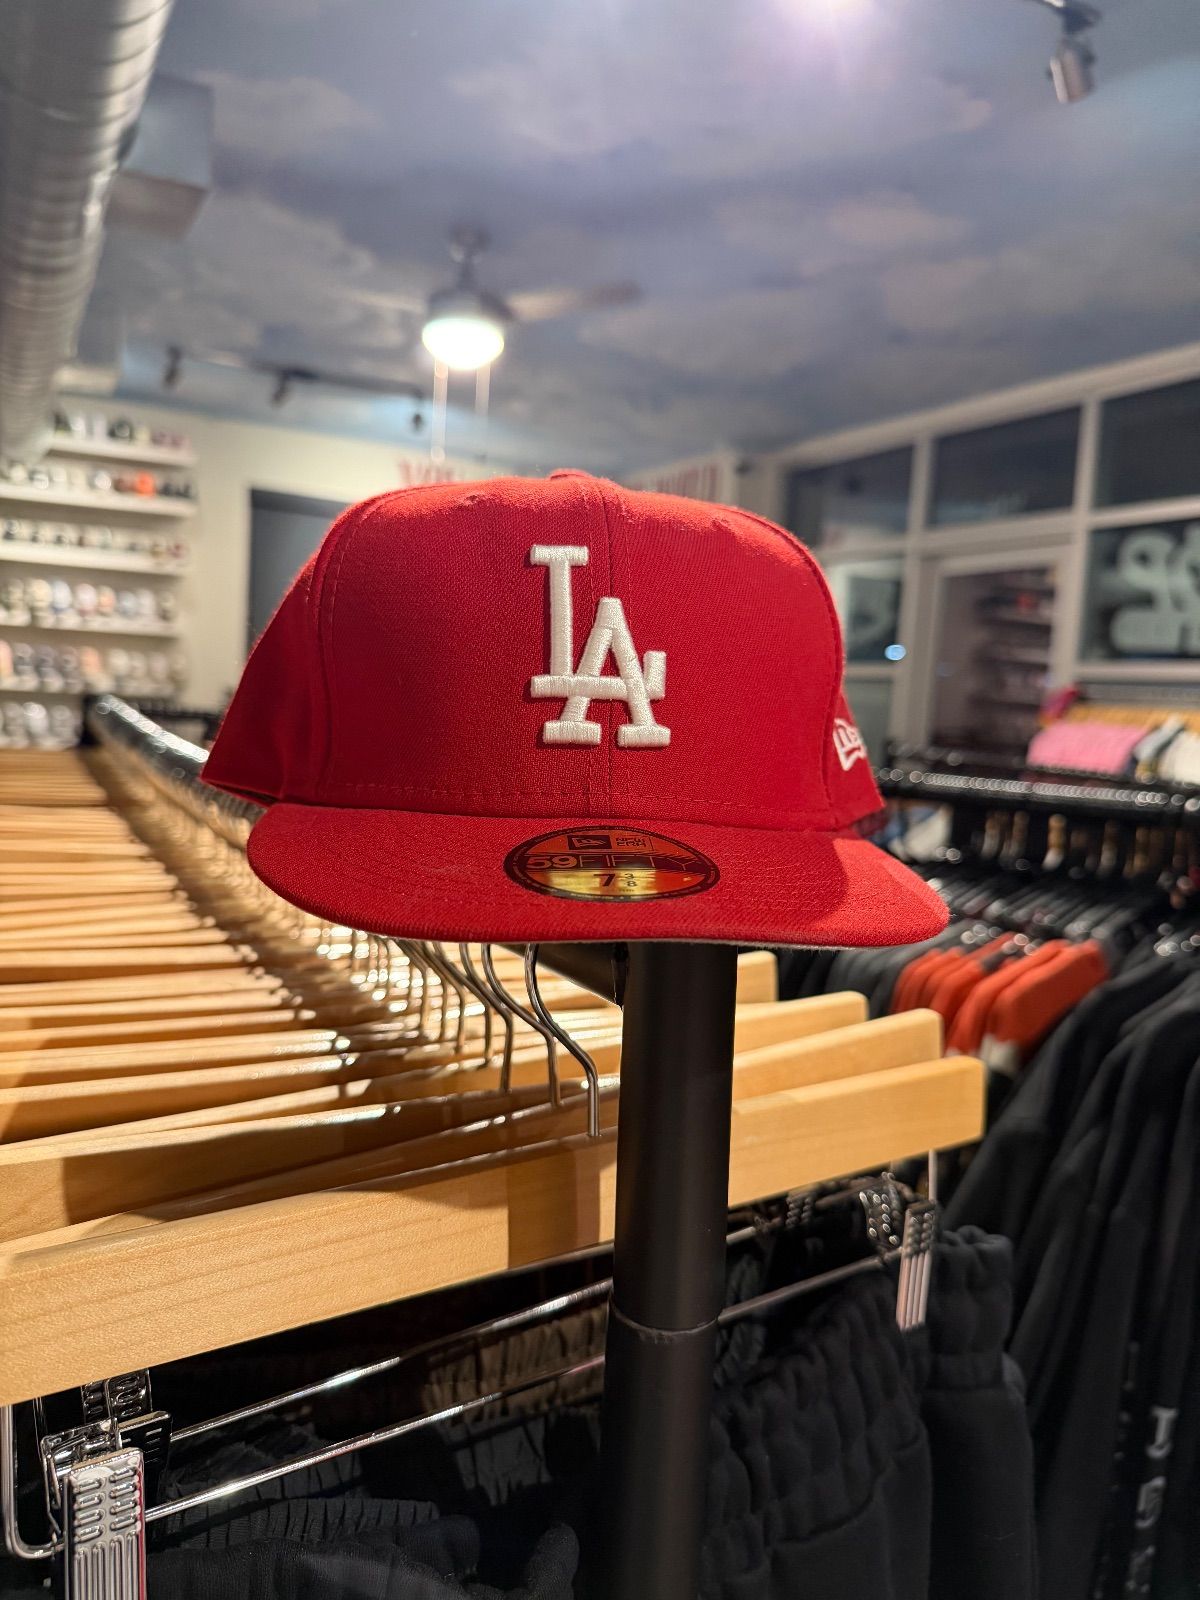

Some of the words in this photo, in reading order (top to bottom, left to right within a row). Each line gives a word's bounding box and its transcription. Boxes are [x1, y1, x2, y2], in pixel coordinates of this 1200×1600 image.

[530, 544, 671, 747] LA
[526, 855, 696, 871] 59FIFTY
[593, 873, 616, 887] 7
